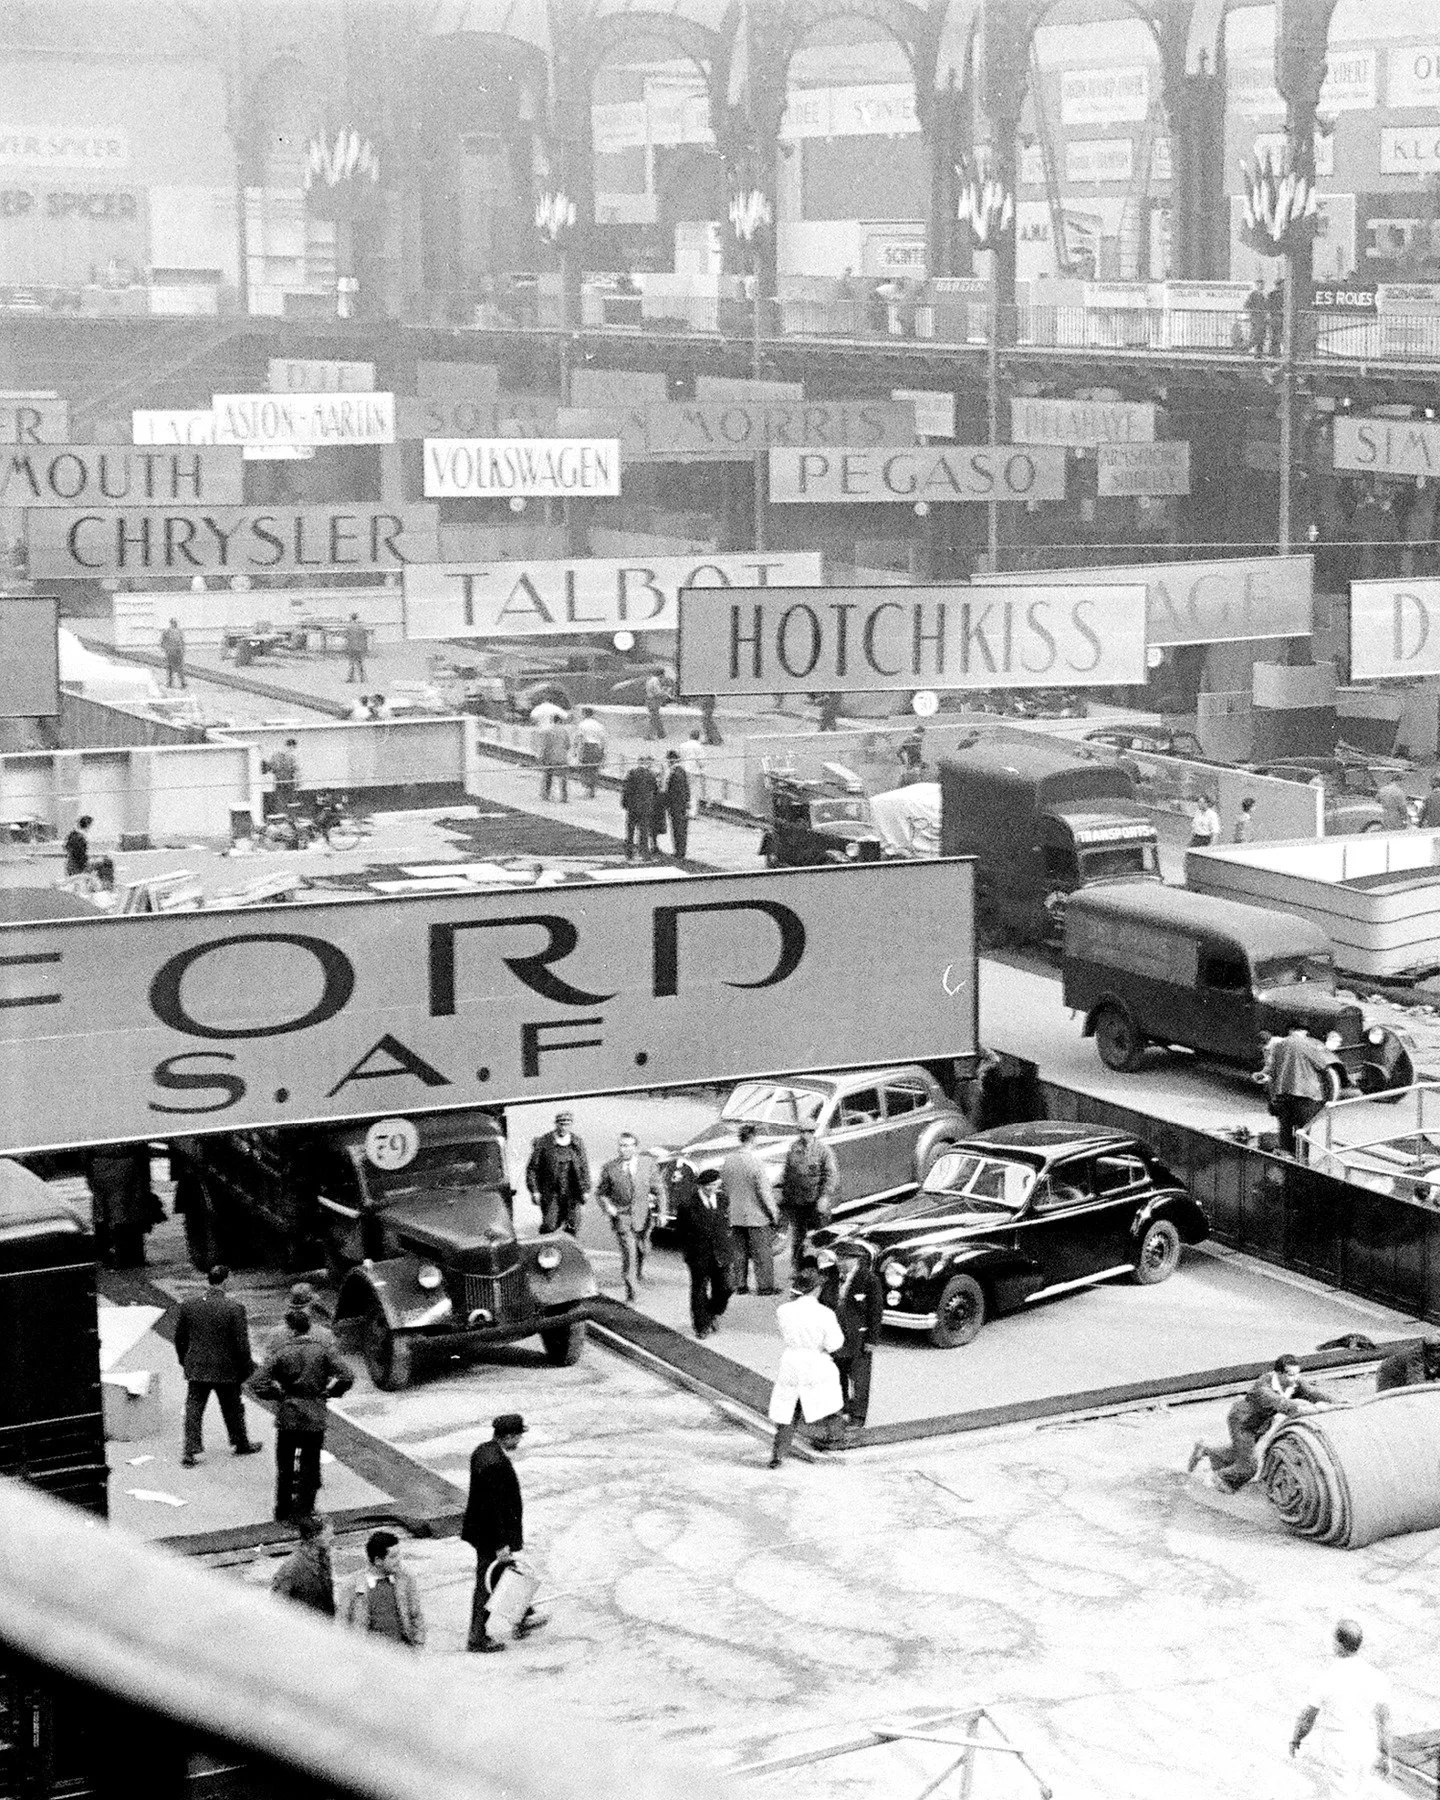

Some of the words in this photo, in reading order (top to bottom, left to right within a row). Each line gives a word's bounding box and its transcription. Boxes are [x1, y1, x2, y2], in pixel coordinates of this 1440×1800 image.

[1311, 291, 1334, 306] ES
[0, 406, 43, 444] R
[672, 405, 887, 445] MORRIS
[431, 446, 612, 489] VOLKSWAGEN
[799, 453, 1036, 496] PEGASO
[66, 513, 411, 568] CHRYSLER
[729, 600, 1102, 680] HOTCHKISS
